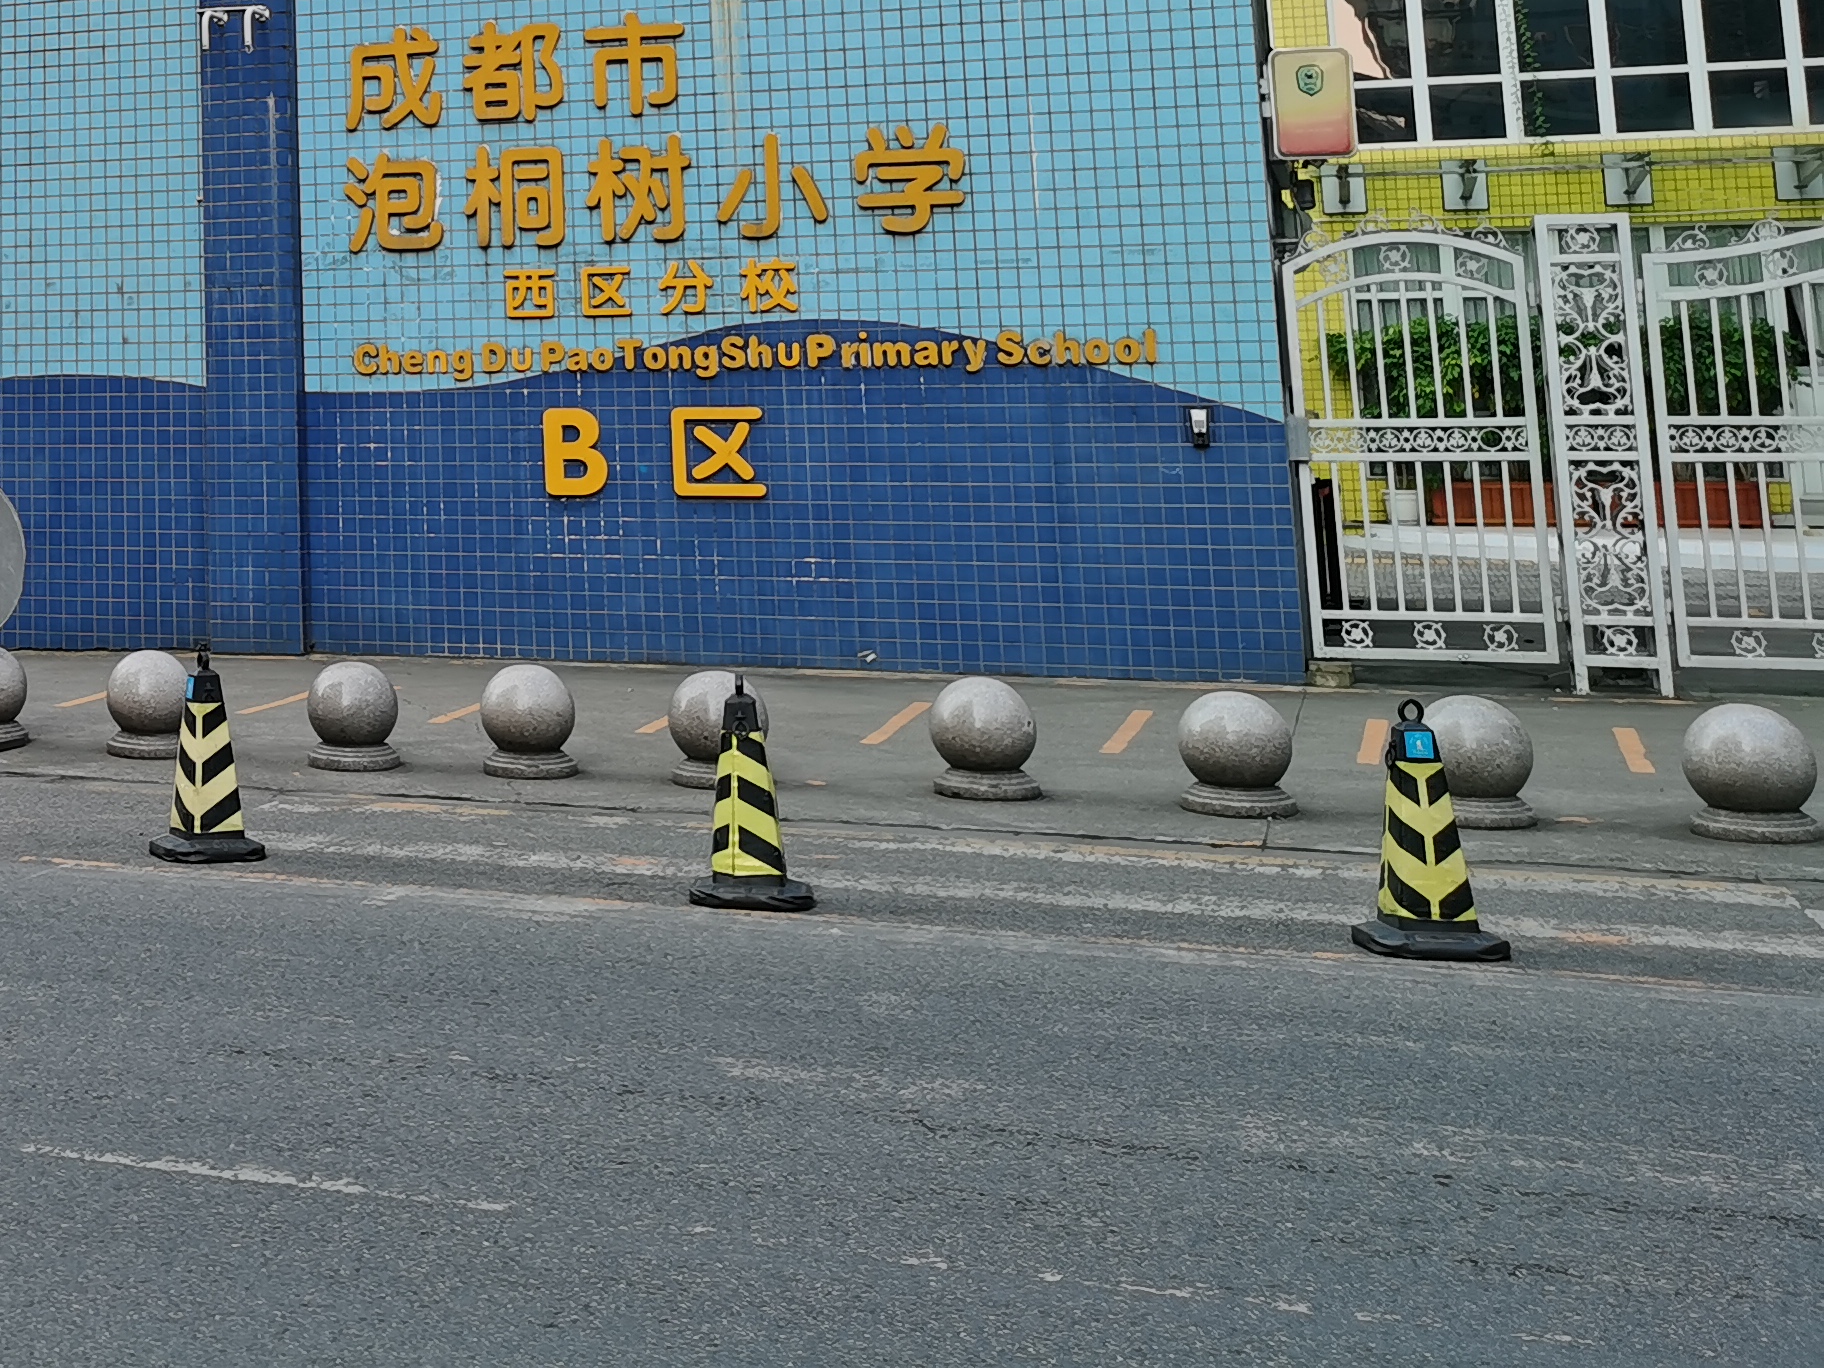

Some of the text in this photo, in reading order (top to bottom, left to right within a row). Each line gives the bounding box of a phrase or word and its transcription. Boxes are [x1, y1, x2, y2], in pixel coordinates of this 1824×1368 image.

[345, 11, 685, 131] 成都市
[343, 122, 966, 253] 泡桐树小学
[503, 257, 798, 319] 西区分校
[995, 327, 1158, 367] School
